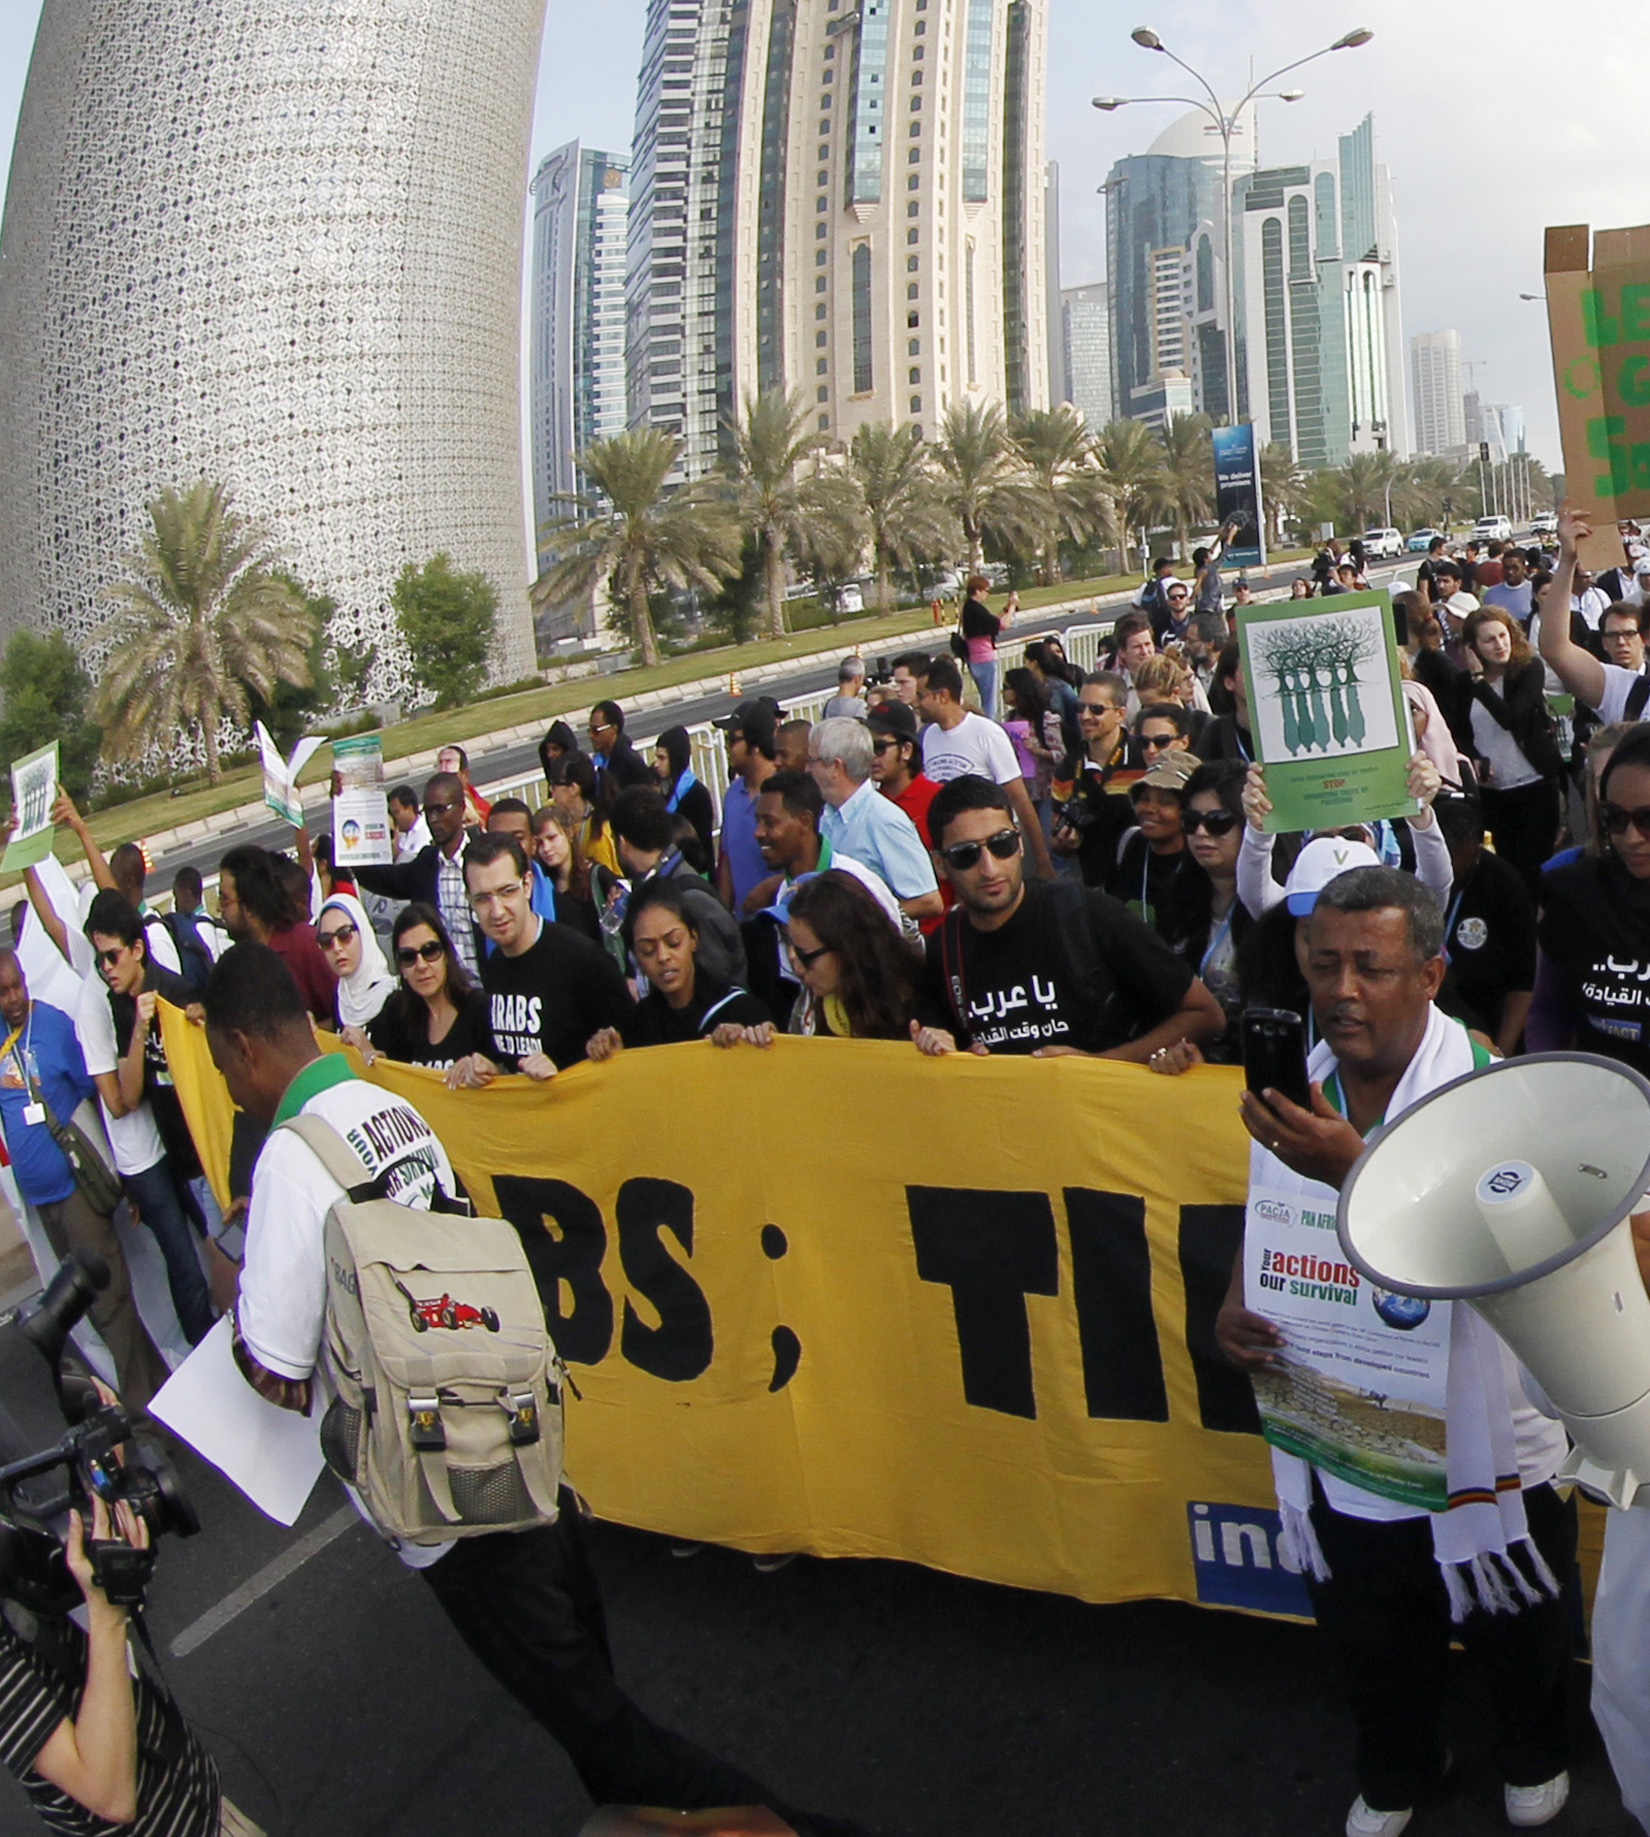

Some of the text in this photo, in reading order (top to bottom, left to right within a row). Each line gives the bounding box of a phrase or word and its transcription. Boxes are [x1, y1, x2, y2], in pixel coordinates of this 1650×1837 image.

[1032, 975, 1058, 1010] يا
[1009, 1022, 1039, 1039] وقت
[1041, 1019, 1069, 1037] حان
[1260, 1203, 1290, 1218] PACJA
[1301, 1210, 1317, 1227] PAN
[1261, 1248, 1360, 1288] Your actions
[1260, 1273, 1358, 1306] our survival
[1353, 1358, 1392, 1371] developed
